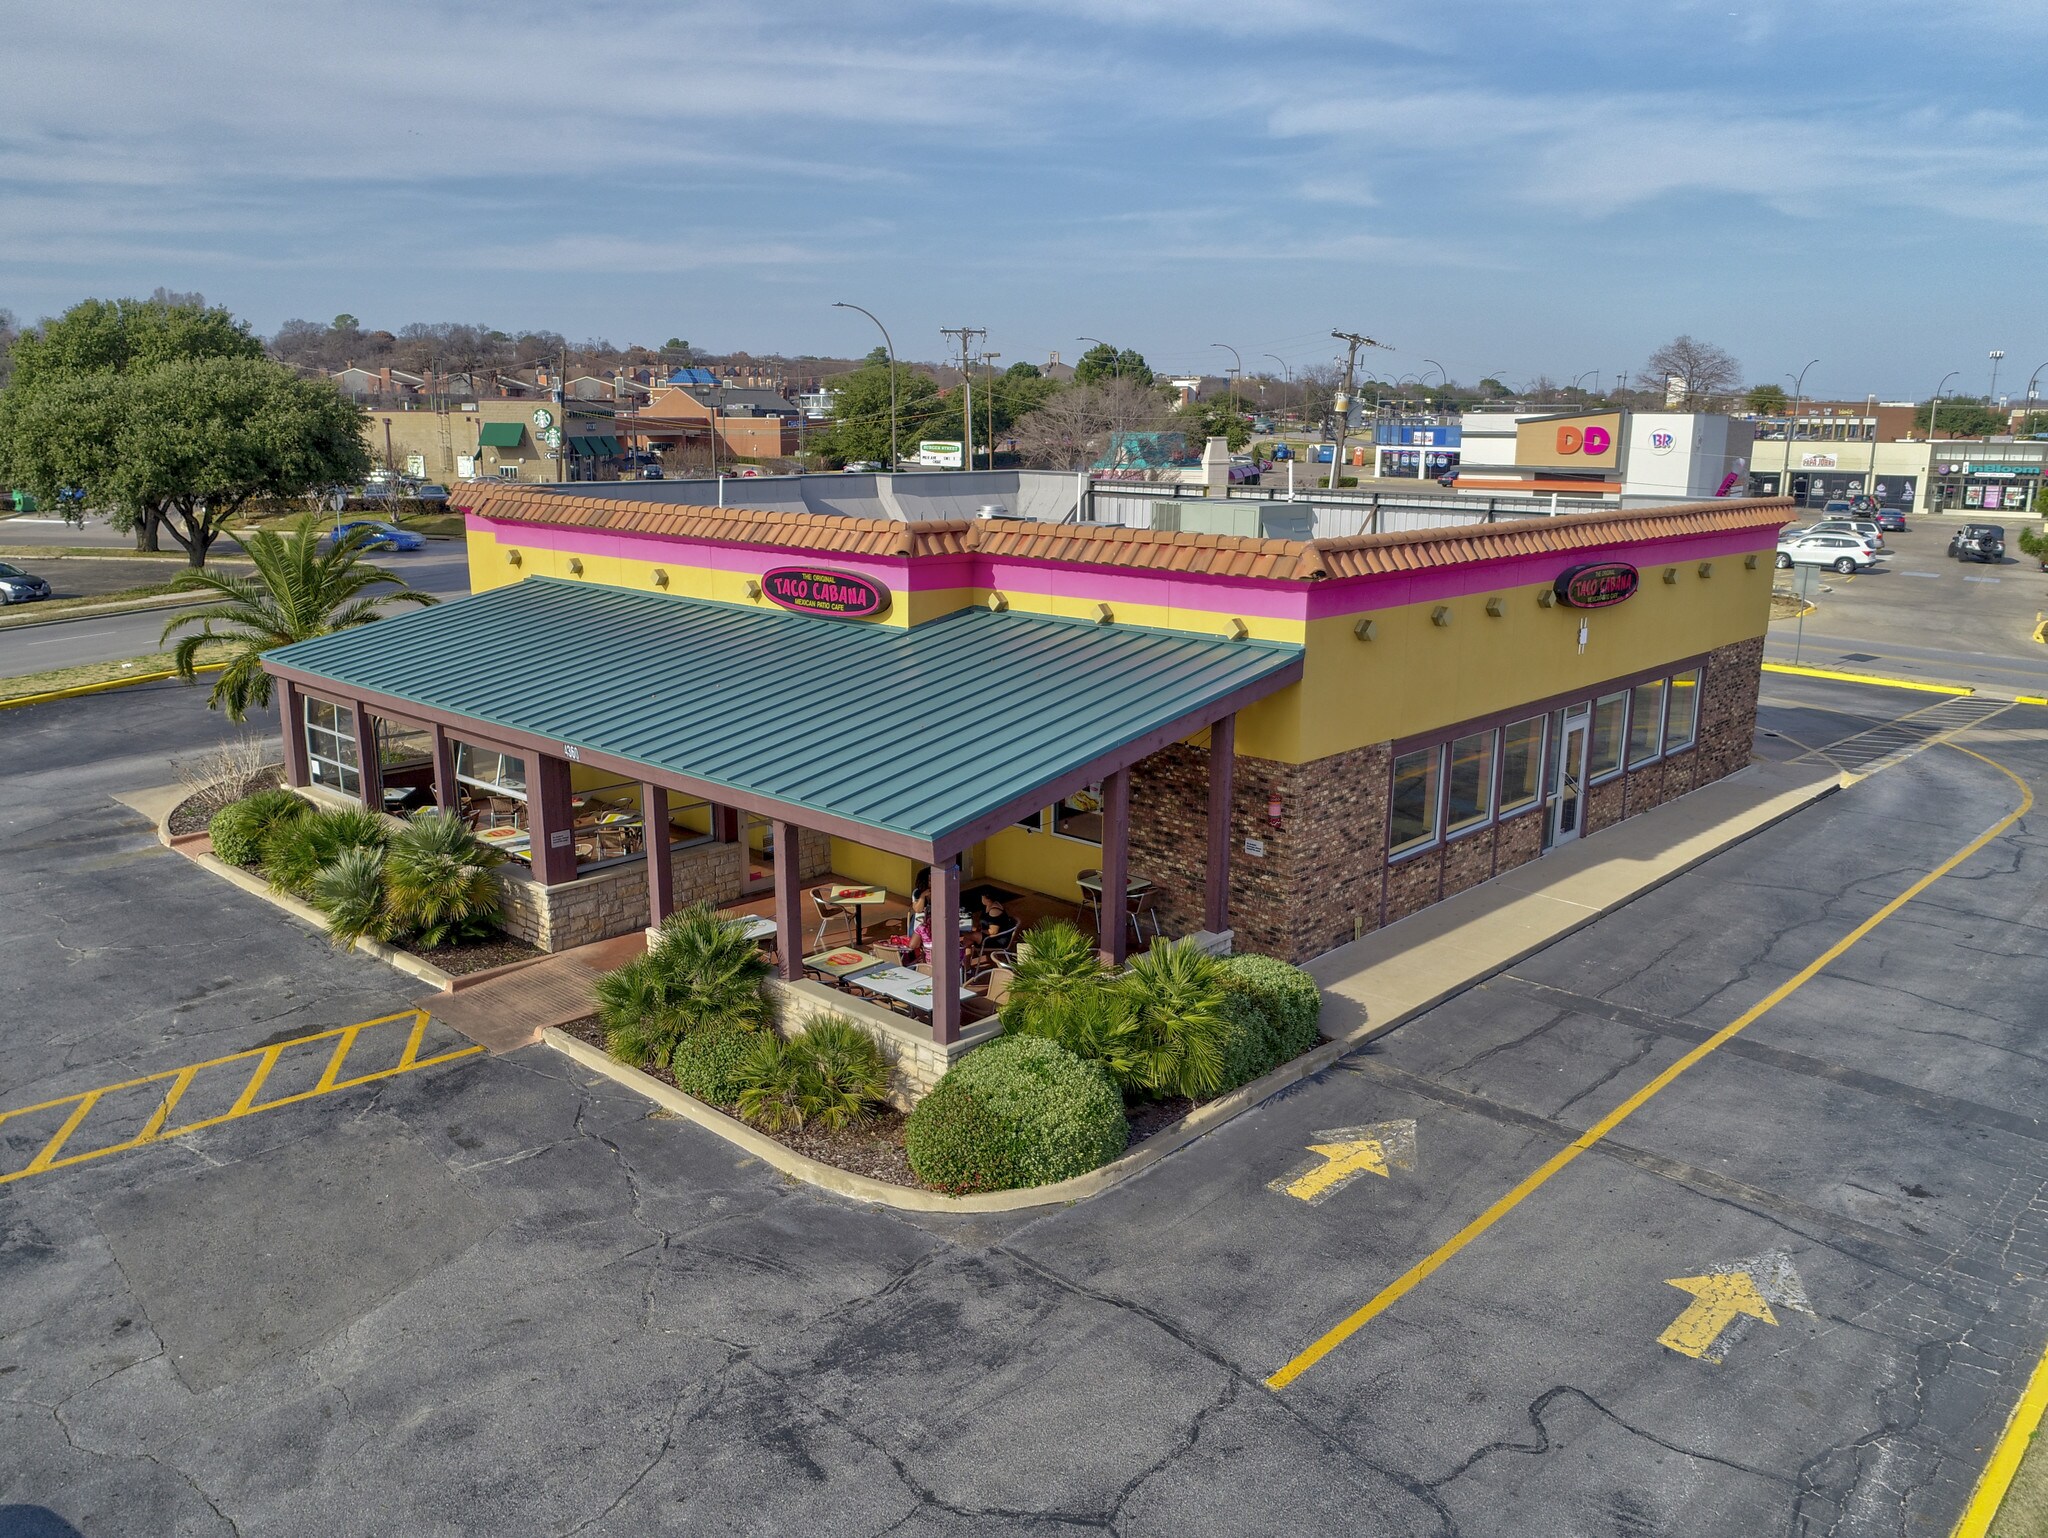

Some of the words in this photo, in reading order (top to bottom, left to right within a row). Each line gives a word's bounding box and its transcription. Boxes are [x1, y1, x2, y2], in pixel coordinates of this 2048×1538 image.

[1556, 426, 1611, 455] DD
[1652, 433, 1674, 448] BR
[1803, 458, 1817, 467] PAPA
[1969, 464, 2040, 474] InBloom
[802, 573, 813, 581] THE
[813, 574, 836, 584] ORIGINAL
[1576, 579, 1598, 597] TACO
[1600, 573, 1632, 594] CABANA
[774, 577, 808, 599] TACO
[812, 582, 867, 607] CABANA
[794, 598, 816, 607] MEXICAN
[816, 600, 831, 610] PATIO
[831, 602, 844, 611] CAFE
